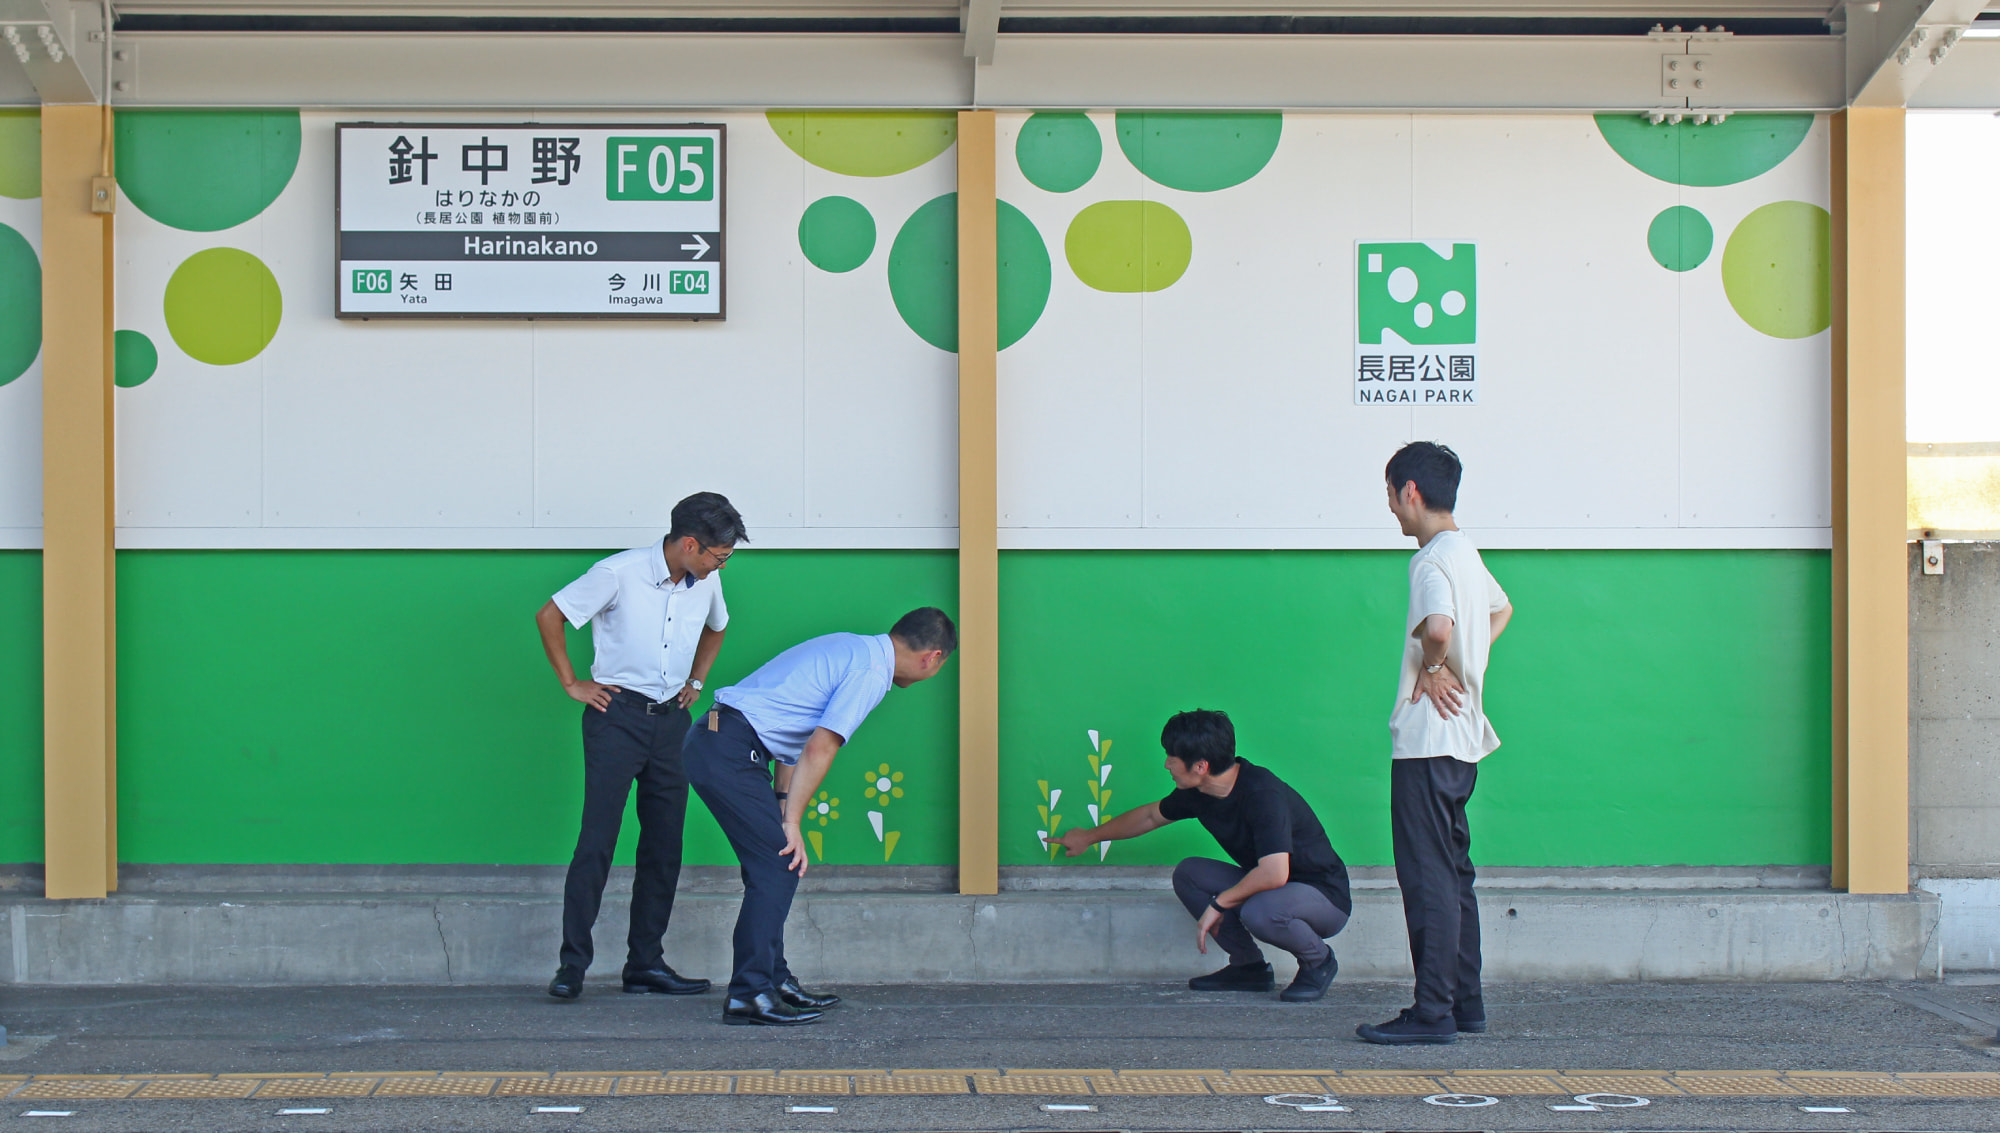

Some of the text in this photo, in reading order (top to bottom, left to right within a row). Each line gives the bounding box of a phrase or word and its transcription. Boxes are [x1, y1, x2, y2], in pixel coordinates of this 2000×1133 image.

[388, 135, 581, 186] 針中野
[435, 190, 541, 207] はりなかの
[464, 235, 598, 256] Harinakano
[356, 272, 388, 291] F06
[400, 294, 428, 304] Yata
[608, 294, 663, 307] Imagawa
[1358, 354, 1475, 382] 長居公園
[1360, 389, 1473, 403] NAGAI PARK
